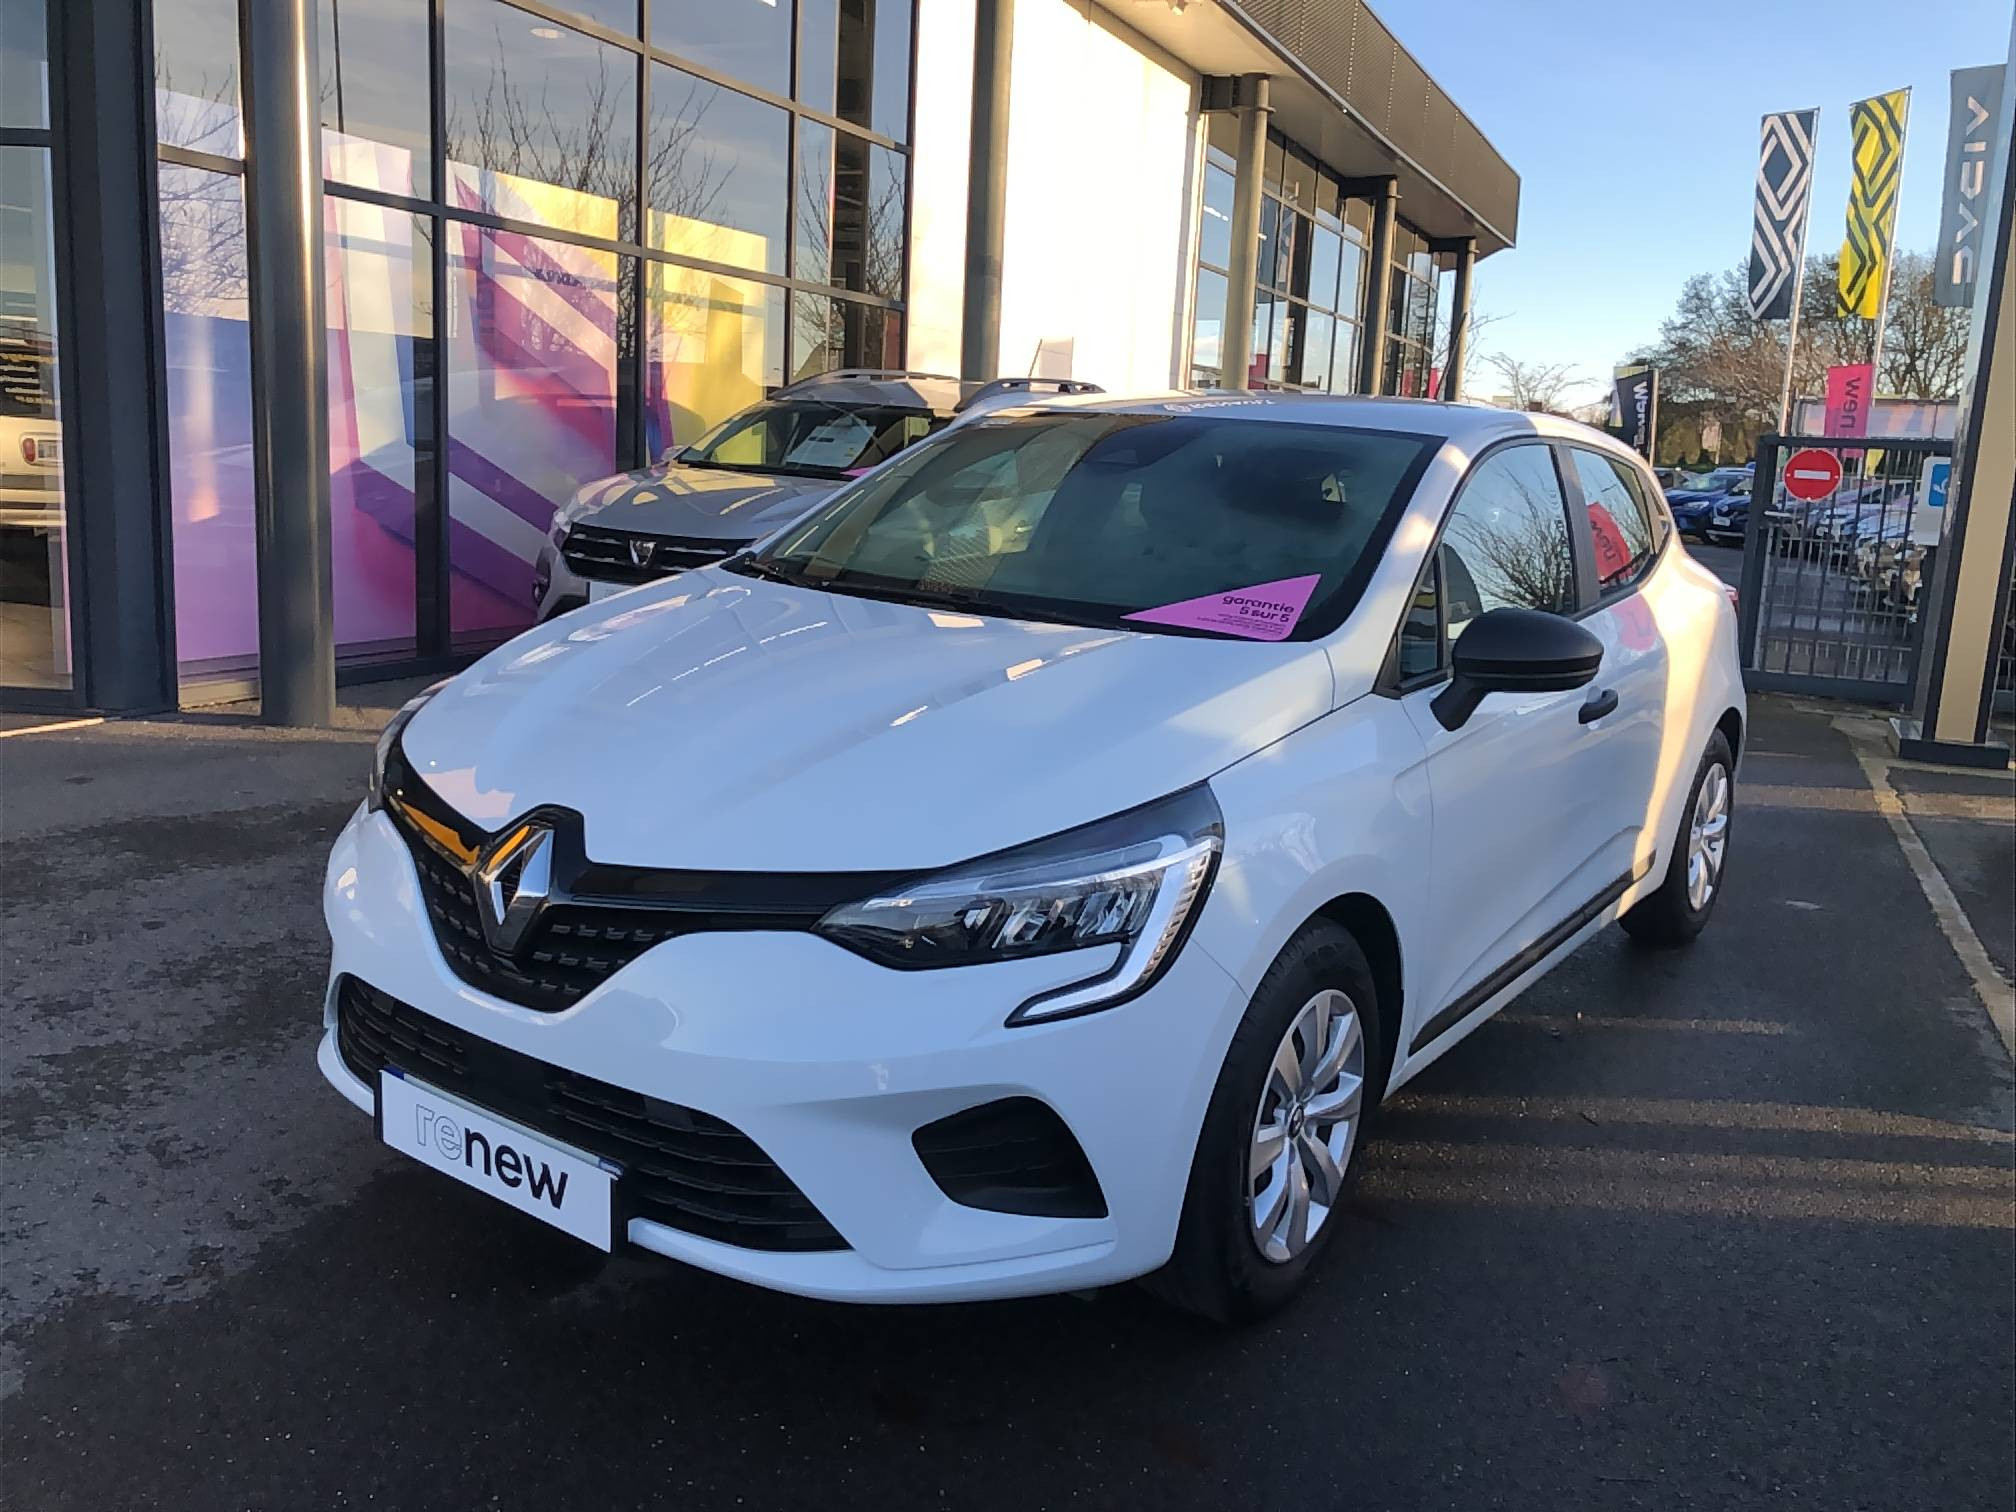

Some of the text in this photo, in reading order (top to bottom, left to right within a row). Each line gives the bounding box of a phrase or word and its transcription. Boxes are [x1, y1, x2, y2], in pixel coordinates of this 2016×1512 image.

[1222, 595, 1295, 613] garantie
[1239, 606, 1291, 622] 5 sur 5
[415, 1103, 569, 1210] renew
